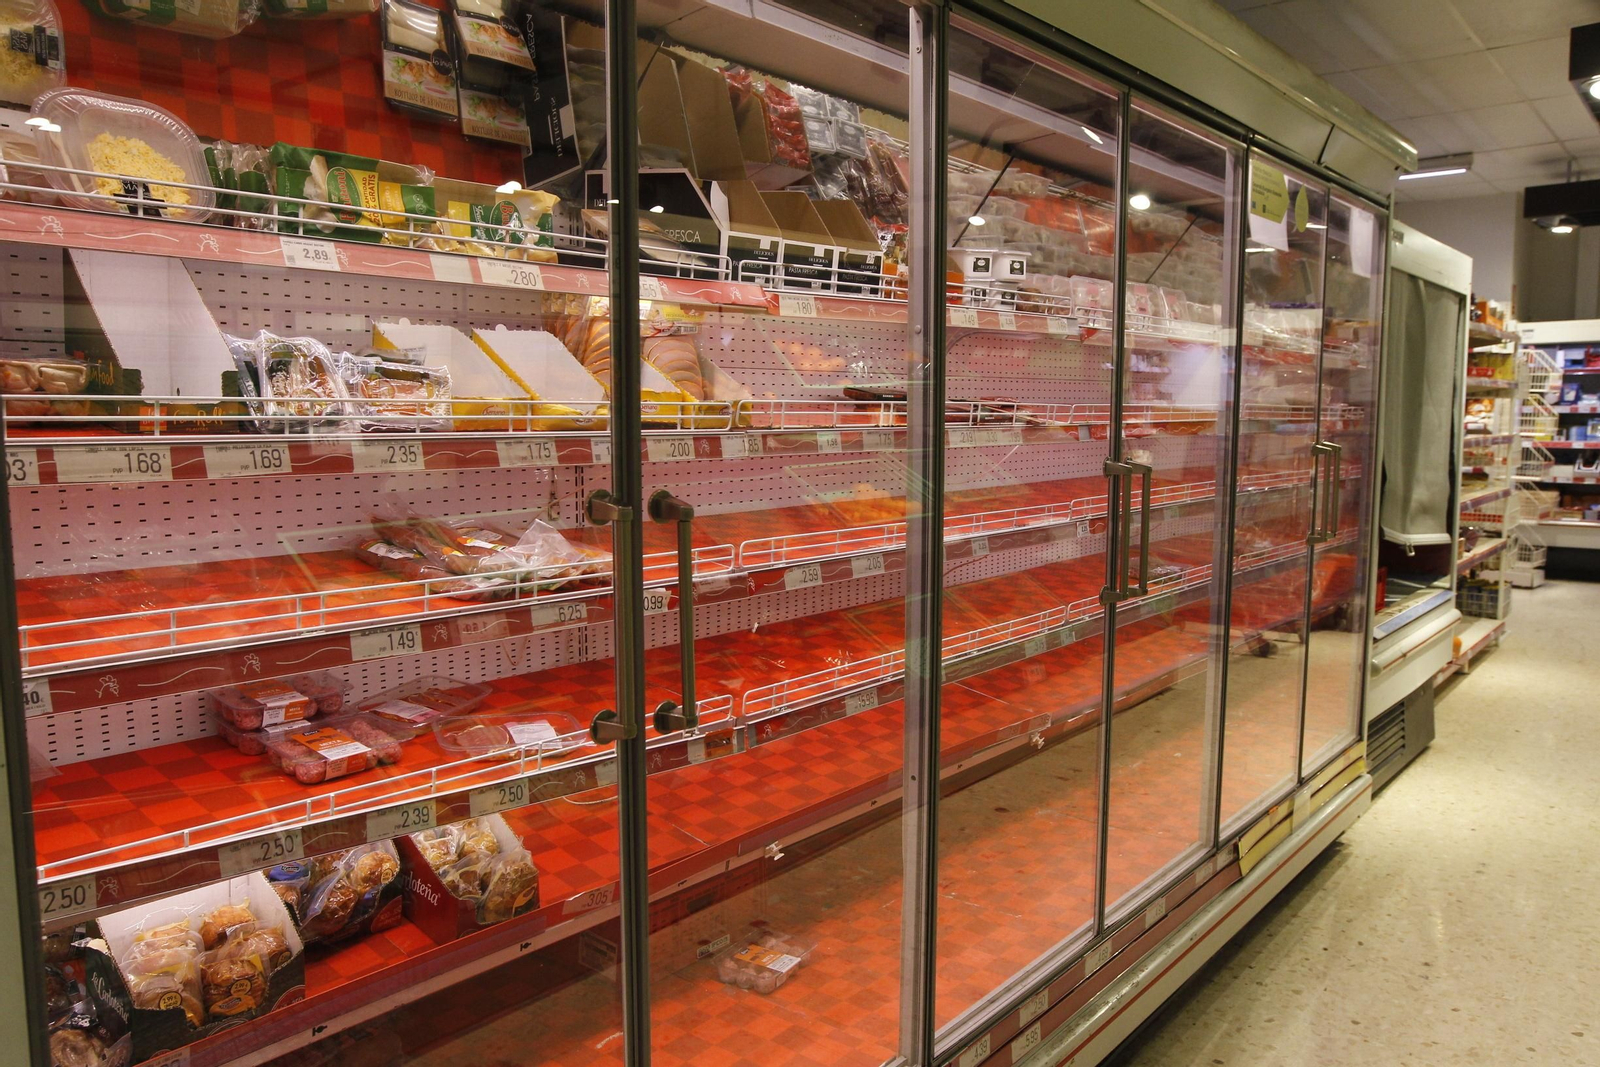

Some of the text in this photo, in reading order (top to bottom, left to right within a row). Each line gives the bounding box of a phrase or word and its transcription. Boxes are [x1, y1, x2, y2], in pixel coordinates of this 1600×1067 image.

[368, 174, 376, 203] GRATIS
[303, 248, 328, 261] 2,89
[124, 452, 161, 474] 1.68
[249, 449, 283, 470] 1.69
[387, 630, 415, 651] 1.49
[401, 806, 430, 828] 2.39
[260, 835, 294, 861] 2.50
[43, 884, 86, 913] 2.50
